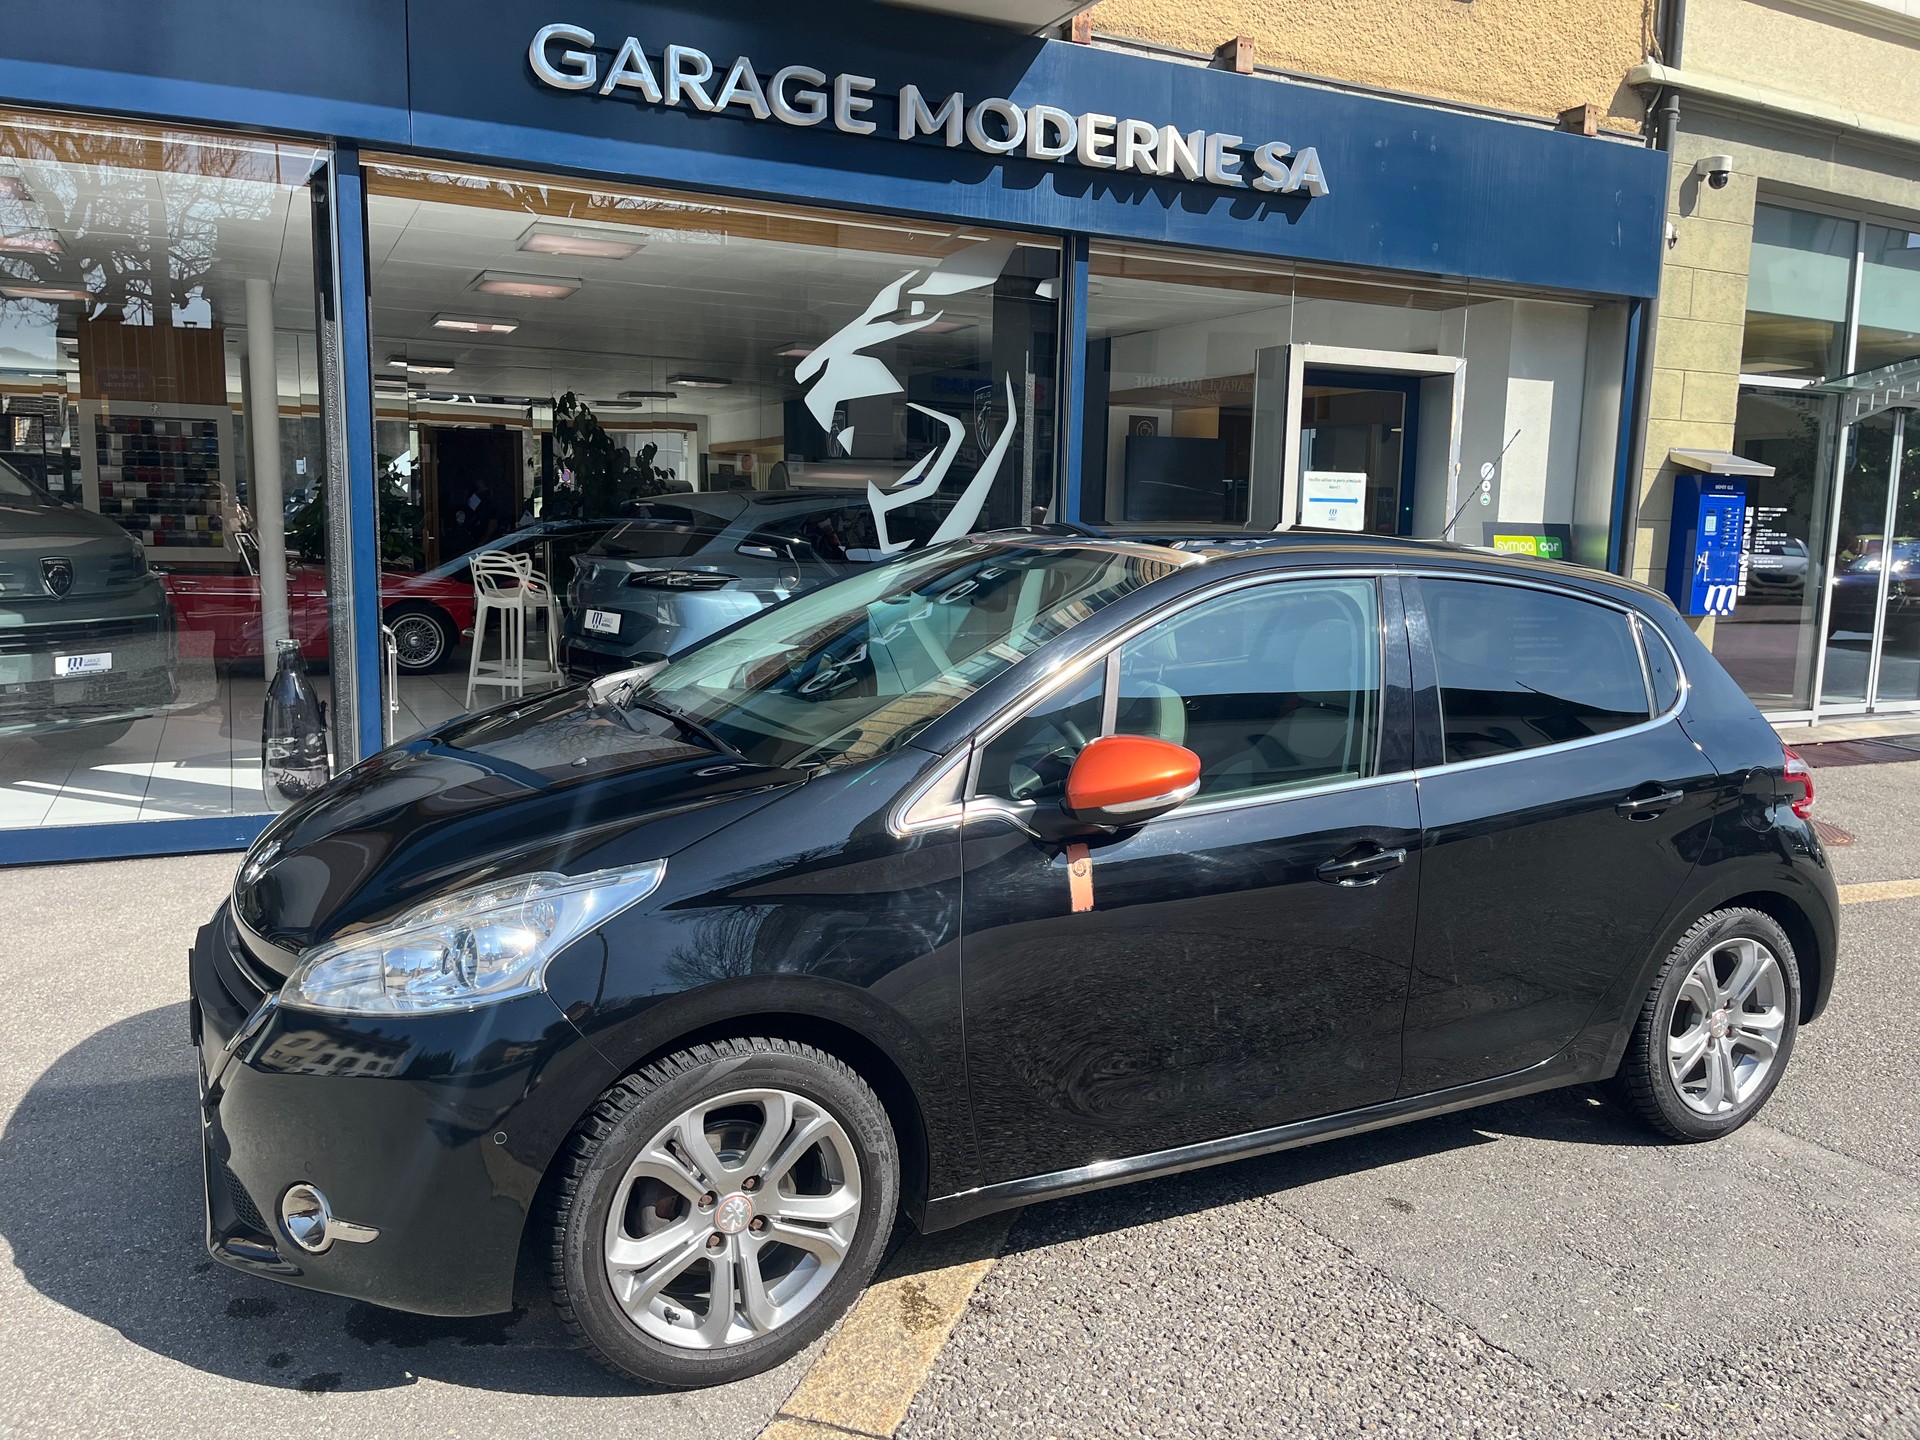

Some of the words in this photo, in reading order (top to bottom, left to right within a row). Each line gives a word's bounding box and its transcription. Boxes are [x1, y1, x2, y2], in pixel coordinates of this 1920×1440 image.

[528, 23, 878, 136] GARAGE
[898, 84, 1244, 186] MODERNE
[1252, 141, 1330, 197] SA
[1539, 541, 1559, 552] car
[1737, 506, 1754, 597] BIENVENUE
